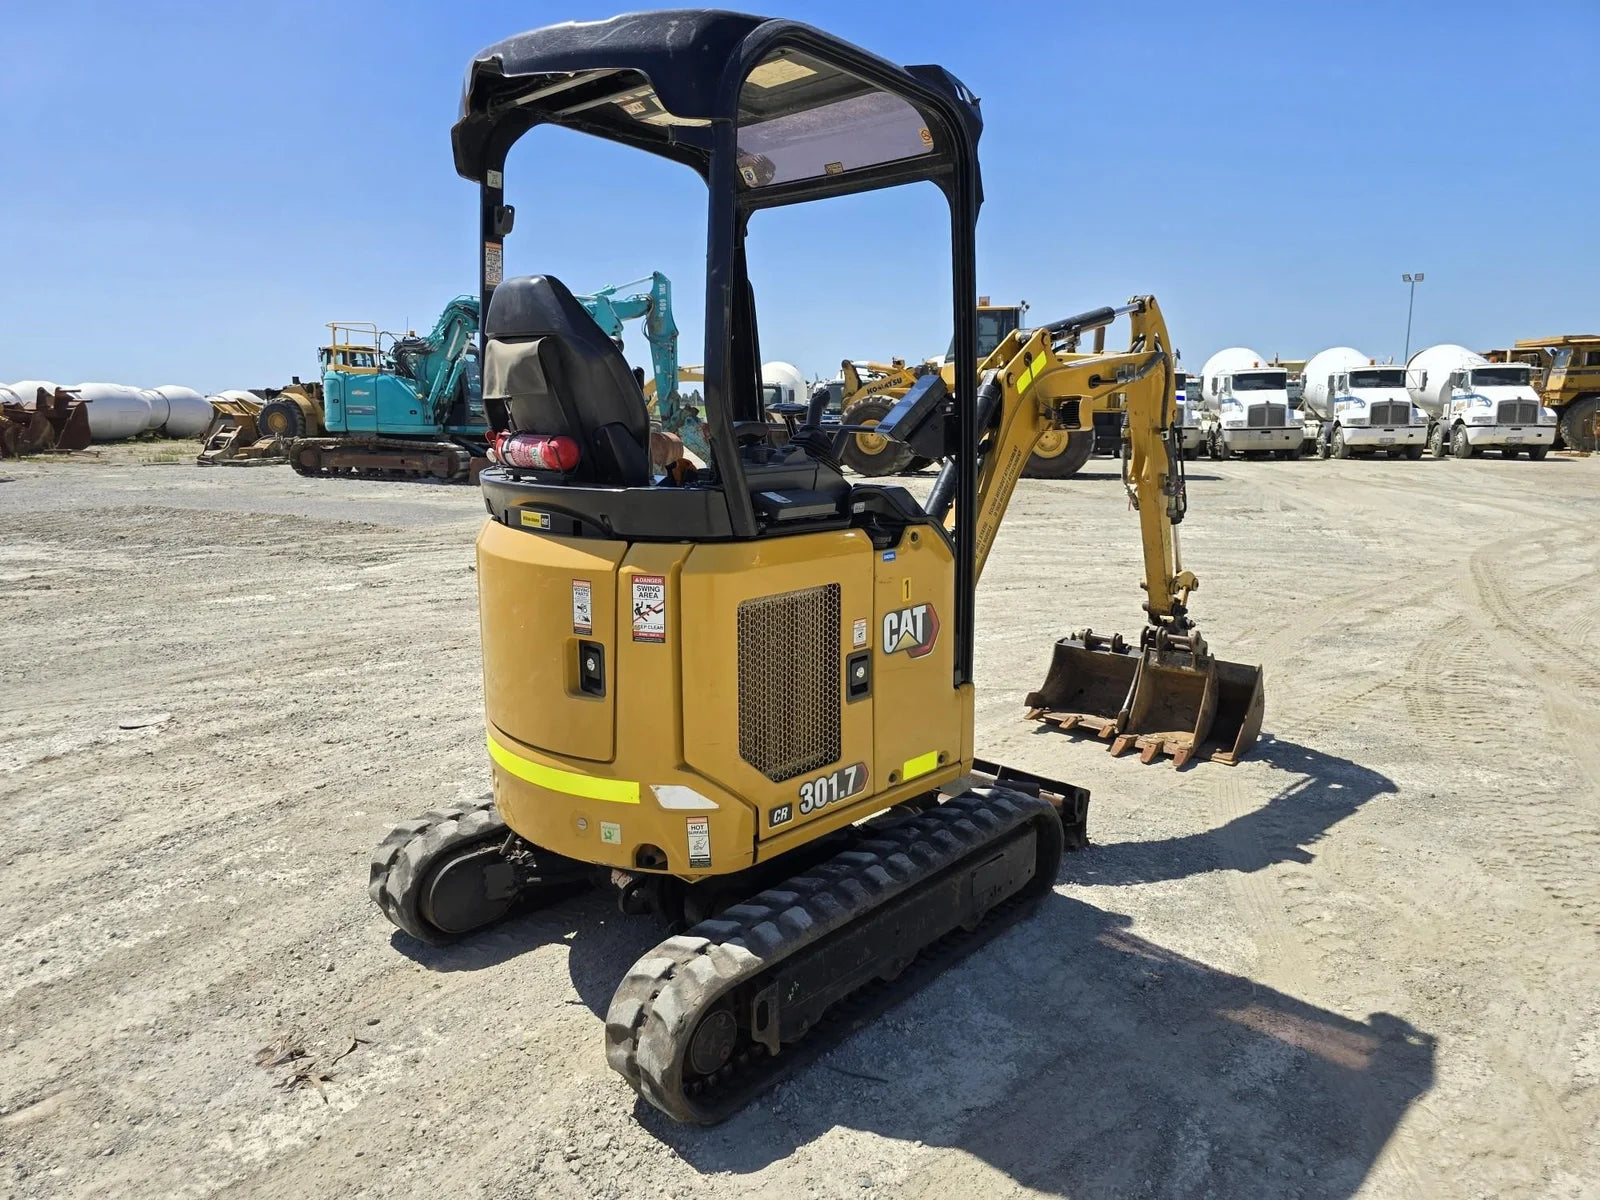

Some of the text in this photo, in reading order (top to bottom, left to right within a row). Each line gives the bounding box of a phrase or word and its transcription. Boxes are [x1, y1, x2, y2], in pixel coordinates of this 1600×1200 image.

[867, 377, 903, 394] KOMATSU
[636, 585, 661, 593] SWING
[904, 579, 910, 600] 1
[883, 604, 927, 654] CAT
[800, 765, 857, 814] 301.7
[773, 806, 789, 824] CR
